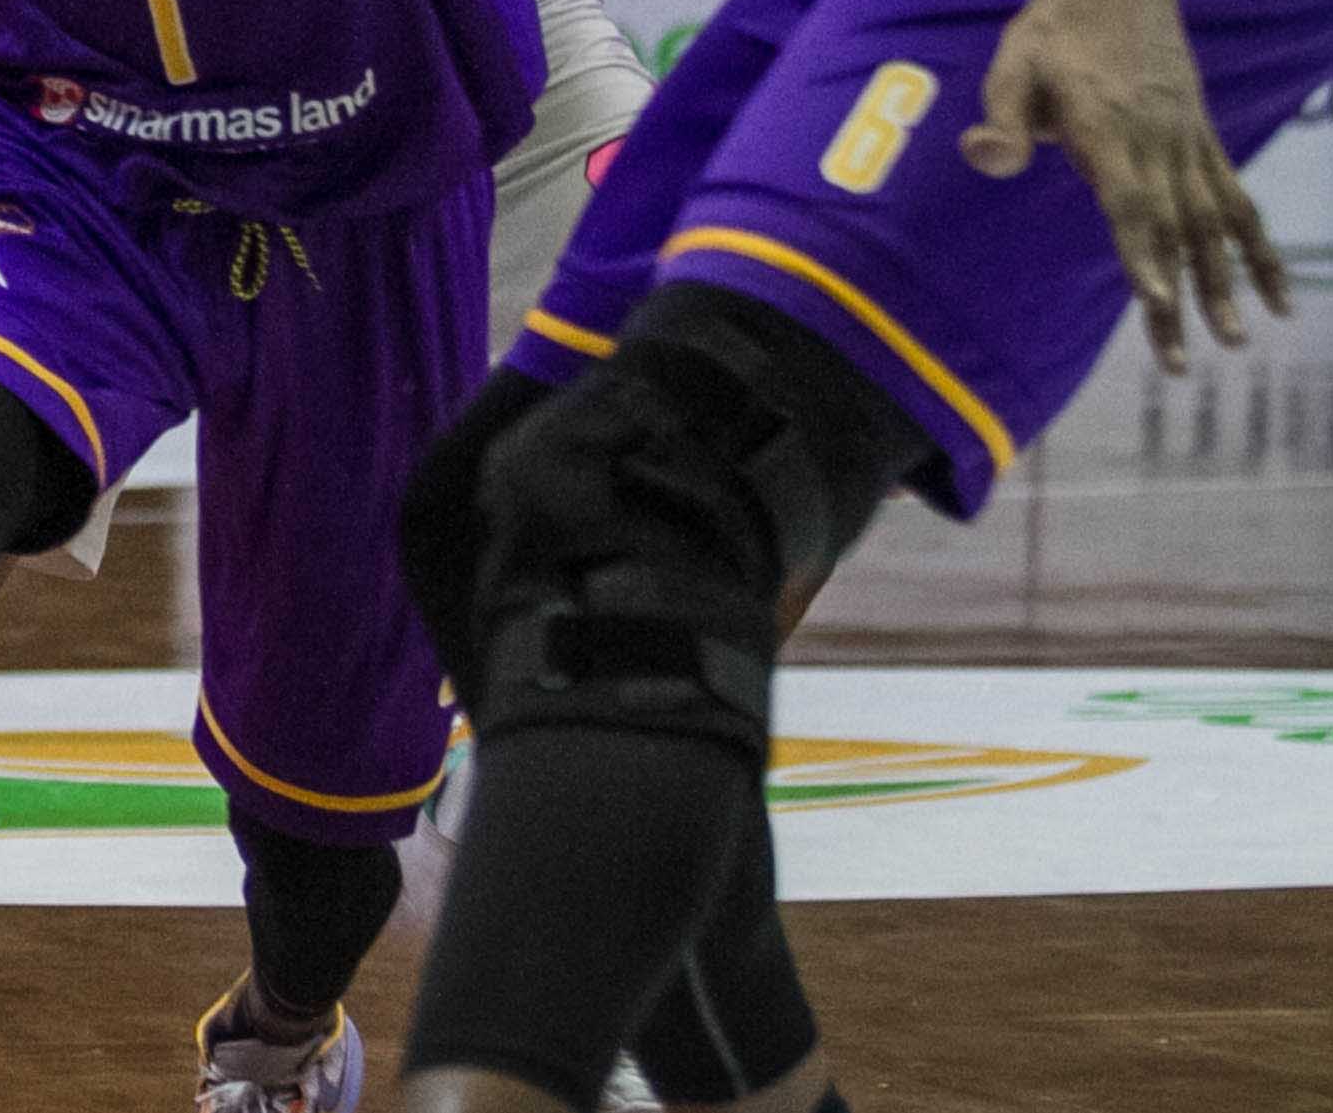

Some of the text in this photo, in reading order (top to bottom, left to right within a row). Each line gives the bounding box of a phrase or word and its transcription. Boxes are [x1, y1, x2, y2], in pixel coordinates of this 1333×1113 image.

[85, 68, 376, 141] sinarmas land
[819, 60, 940, 194] 6
